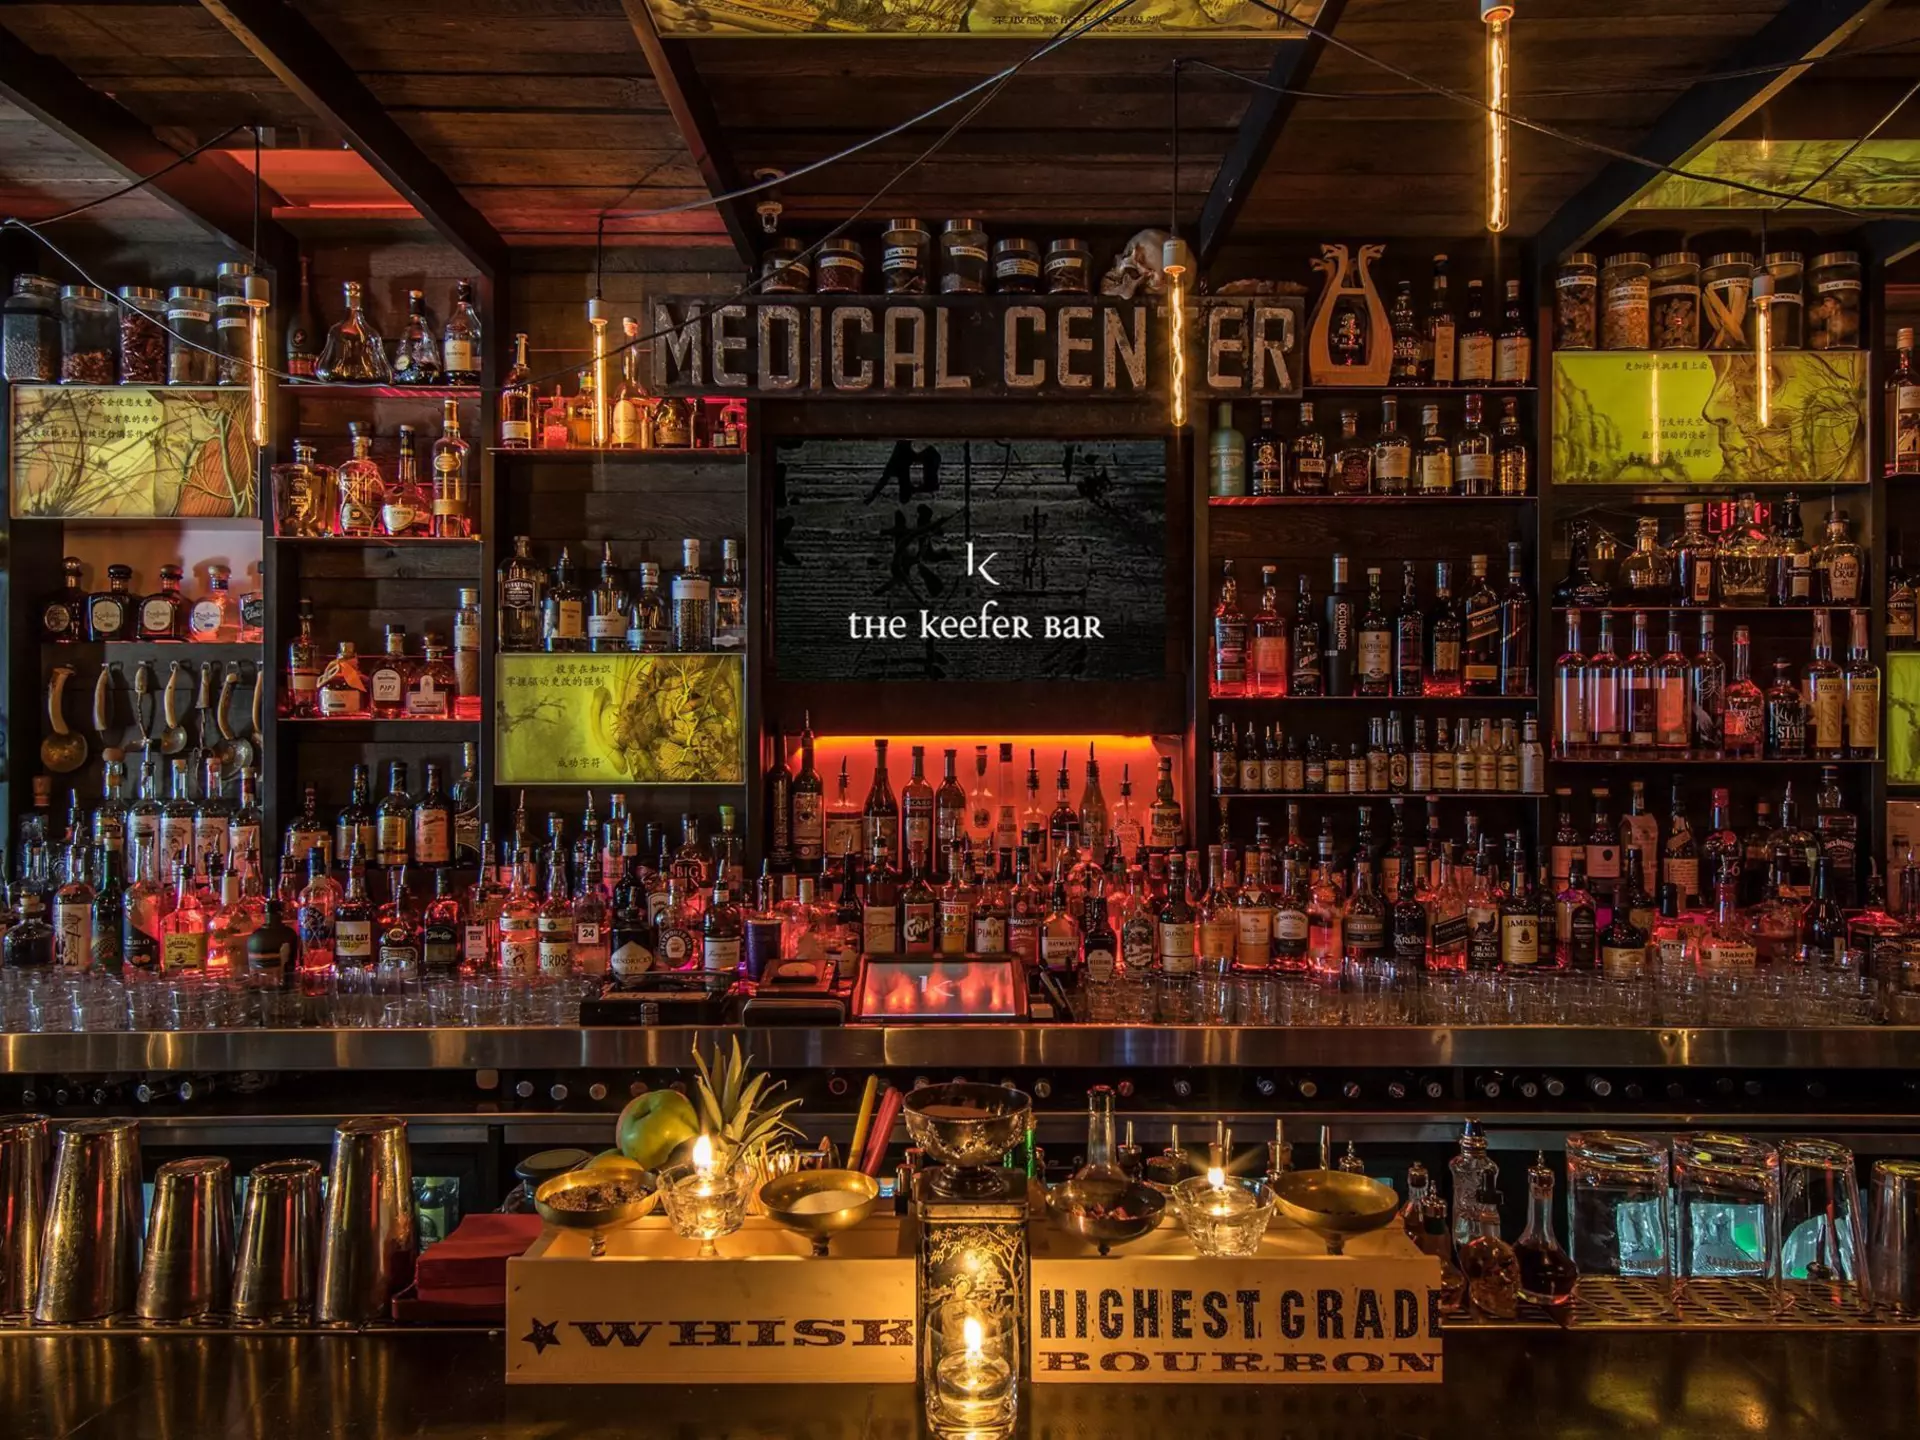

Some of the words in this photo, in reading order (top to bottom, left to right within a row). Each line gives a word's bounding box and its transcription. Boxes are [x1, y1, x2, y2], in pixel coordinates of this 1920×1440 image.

[653, 305, 972, 389] MEDICAL
[1338, 602, 1347, 650] OCTOMORE
[582, 929, 595, 938] 24
[1505, 919, 1539, 928] JAMESO
[1039, 1288, 1261, 1340] HIGHEST
[1279, 1288, 1443, 1340] GRADE
[569, 1320, 913, 1346] WHISK
[1039, 1351, 1443, 1372] BOURBON
